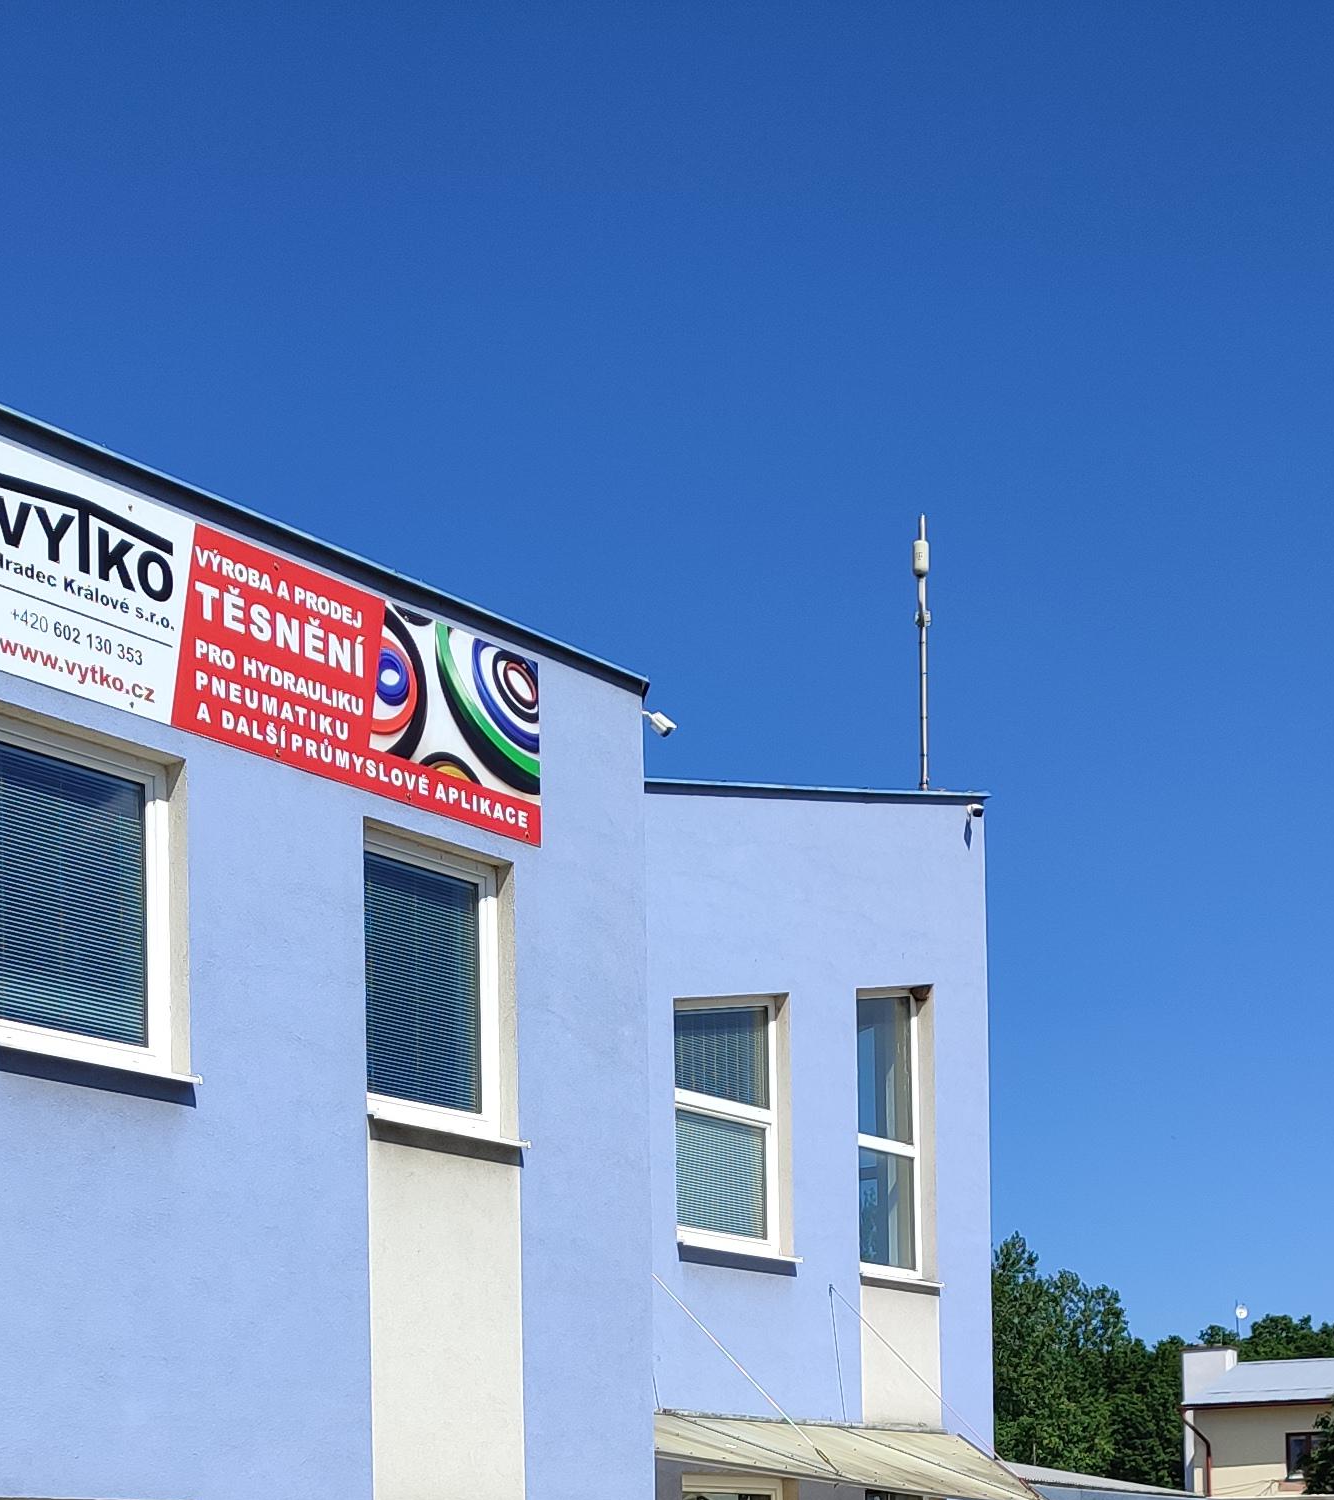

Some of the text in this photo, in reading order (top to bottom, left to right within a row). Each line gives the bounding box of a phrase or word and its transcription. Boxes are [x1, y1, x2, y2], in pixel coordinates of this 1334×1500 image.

[64, 576, 130, 614] Králové
[135, 607, 175, 631] s.r.o.
[194, 545, 363, 629] VÝROBA A PRODEJ
[11, 609, 143, 666] +420 602 130 353
[194, 580, 365, 678] TĚSNĚNÍ
[195, 638, 364, 716] PRO HYDRAULIKU
[195, 670, 349, 741] PNEUMATIKU
[196, 702, 529, 829] A DALŠÍ PRŮMYSLOVÉ APLIKACE
